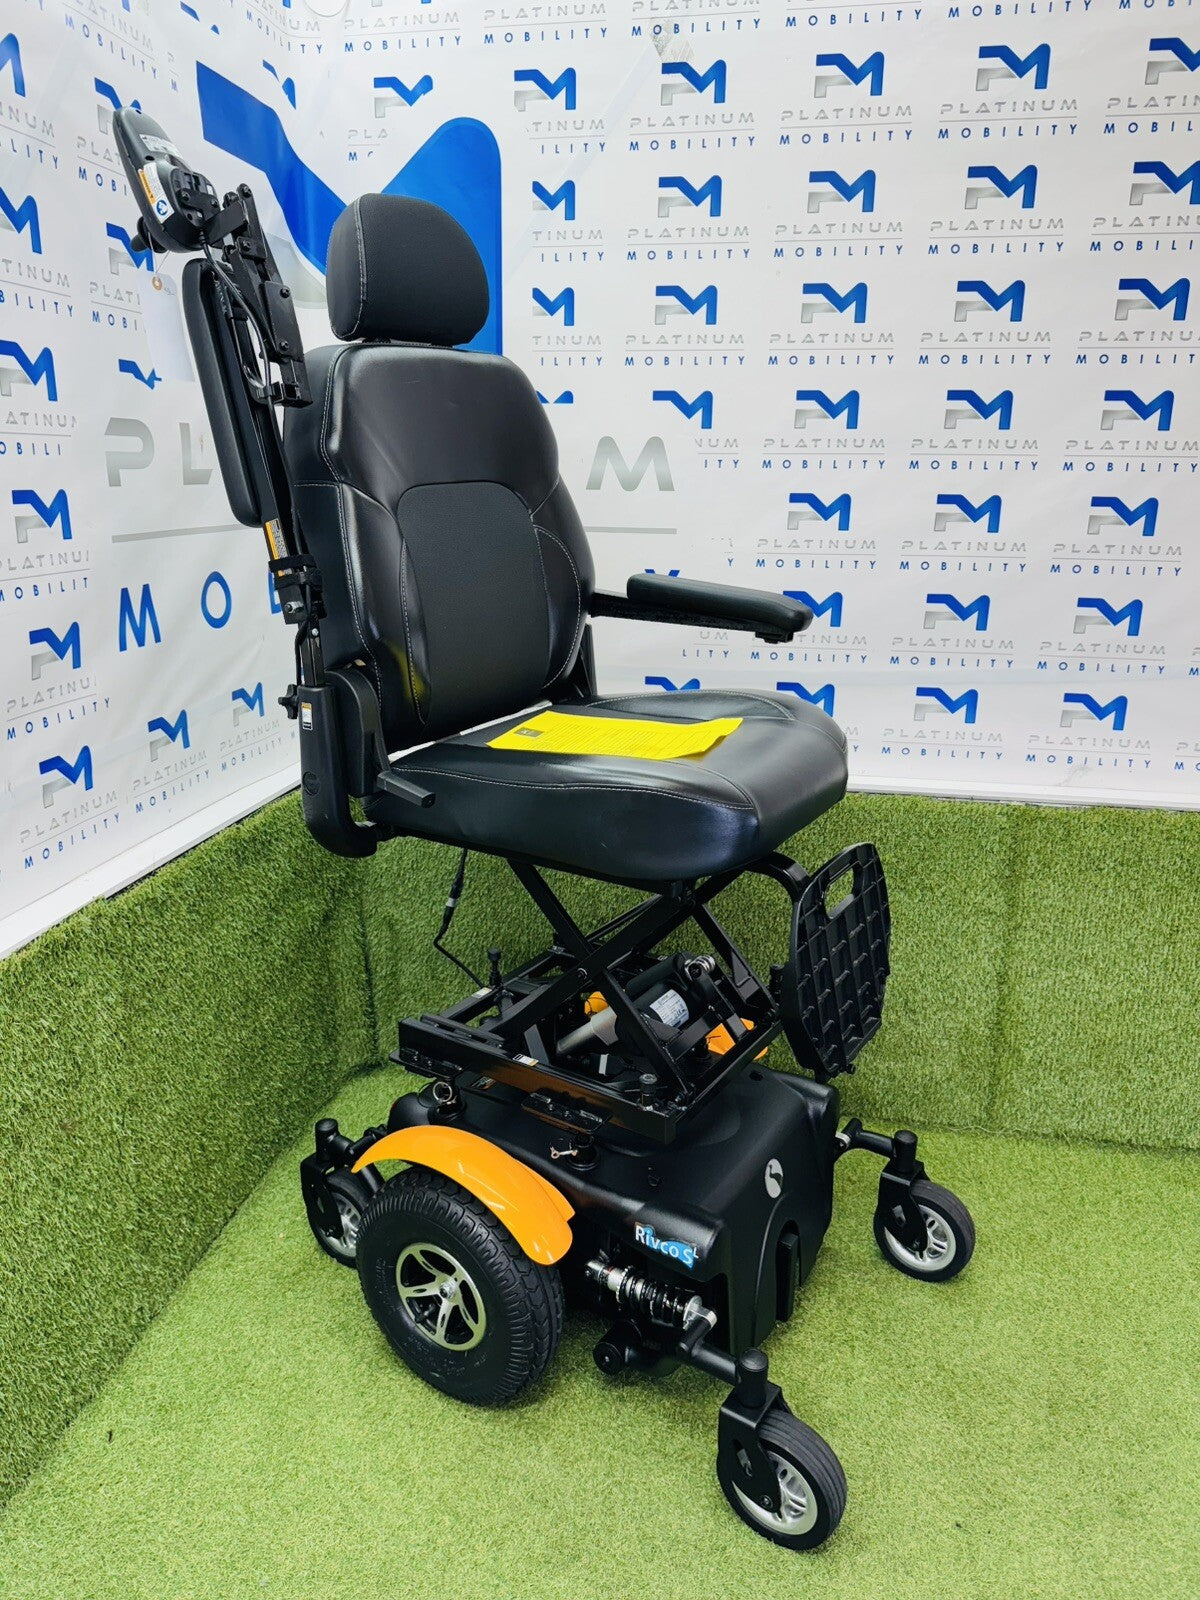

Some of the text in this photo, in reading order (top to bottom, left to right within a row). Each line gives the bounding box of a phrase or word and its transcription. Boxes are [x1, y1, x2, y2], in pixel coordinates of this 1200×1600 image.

[484, 3, 607, 21] PLATINUM
[948, 0, 1092, 19] MOBILITY
[344, 11, 460, 30] PLATINUM
[785, 9, 922, 27] MOBILITY
[632, 18, 760, 36] MOBILITY
[484, 28, 607, 44] MOBILITY
[65, 14, 158, 79] MOBILITY
[344, 36, 461, 52] MOBILITY
[939, 98, 1078, 115] PLATINUM
[1107, 94, 1200, 109] PLATI
[629, 111, 755, 128] PLATINUM
[780, 104, 912, 121] PLATINUM
[530, 118, 605, 132] TINUM
[938, 123, 1078, 140] MOBILITY
[1104, 120, 1194, 134] MOBIL
[629, 135, 755, 151] MOBILITY
[779, 129, 912, 146] MOBILITY
[541, 142, 606, 154] ILITY
[79, 166, 127, 196] MOBI
[775, 221, 903, 235] PLATINUM
[929, 217, 1064, 232] PLATINUM
[1092, 215, 1200, 228] PLATIN
[532, 229, 603, 241] TINUM
[627, 225, 749, 239] PLATINUM
[773, 245, 903, 258] MOBILITY
[928, 241, 1064, 255] MOBILITY
[1090, 240, 1194, 252] MOBILI
[541, 252, 604, 263] ILITY
[626, 248, 750, 261] MOBILITY
[1, 258, 70, 288] TINUM
[90, 281, 141, 306] PLATI
[0, 290, 73, 317] BILITY
[92, 311, 138, 331] MOBI
[532, 334, 602, 346] TINUM
[625, 334, 744, 345] PLATINUM
[769, 332, 894, 344] PLATINUM
[920, 331, 1051, 343] PLATINUM
[1079, 330, 1200, 342] PLATINU
[541, 356, 602, 367] ILITY
[625, 356, 745, 366] MOBILITY
[768, 354, 894, 366] MOBILITY
[918, 354, 1051, 365] MOBILITY
[1076, 353, 1196, 365] MOBILIT
[6, 411, 76, 427] ATINU
[0, 441, 61, 455] OBILI
[763, 438, 885, 449] PLATINUM
[911, 438, 1039, 450] PLATINUM
[1065, 440, 1199, 451] PLATINUM
[762, 459, 886, 470] MOBILITY
[909, 460, 1039, 471] MOBILITY
[1062, 462, 1199, 473] MOBILITY
[757, 539, 876, 550] PLATINUM
[901, 541, 1027, 552] PLATINUM
[1052, 543, 1182, 556] PLATINUM
[0, 550, 89, 571] LATINU
[755, 558, 877, 570] MOBILITY
[899, 561, 1027, 573] MOBILITY
[1050, 563, 1182, 576] MOBILITY
[0, 577, 87, 601] OBILIT
[797, 634, 867, 645] TINUM
[891, 637, 1014, 650] PLATINUM
[682, 649, 729, 659] LITY
[1039, 641, 1166, 655] PLATINUM
[750, 651, 867, 664] MOBILITY
[890, 656, 1014, 668] MOBILITY
[1037, 660, 1166, 675] MOBILITY
[7, 677, 96, 713] PLATINU
[7, 698, 110, 740] MOBILITY
[882, 728, 1003, 743] PLATINUM
[1027, 734, 1151, 750] PLATINUM
[221, 737, 283, 772] MOBILITY
[881, 746, 1003, 760] MOBILITY
[1025, 754, 1151, 769] MOBILITY
[133, 750, 207, 791] PLATINUM
[135, 770, 210, 813] MOBILITY
[20, 790, 117, 843] PLATINUM
[24, 813, 120, 869] MOBILITY
[635, 1224, 678, 1258] Rivco
